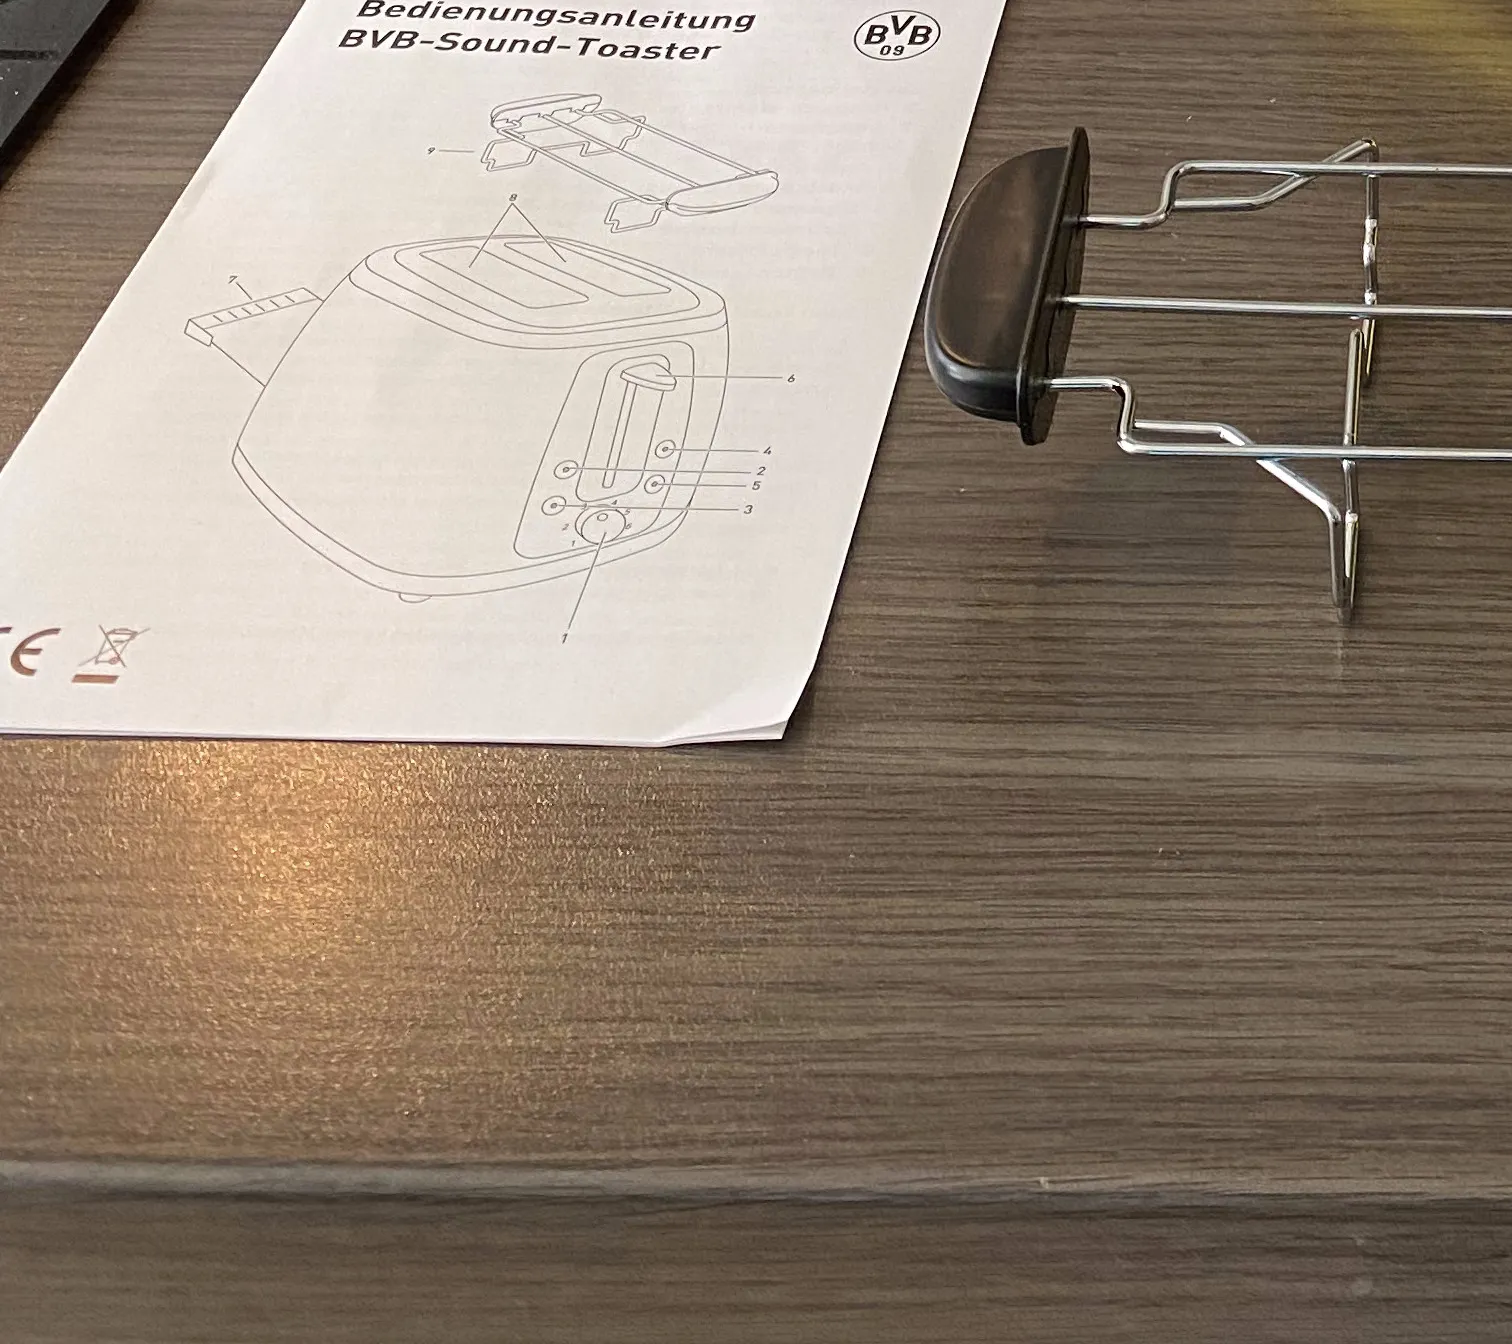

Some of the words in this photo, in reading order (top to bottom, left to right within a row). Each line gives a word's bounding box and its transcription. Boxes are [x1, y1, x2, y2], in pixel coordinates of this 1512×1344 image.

[356, 0, 757, 33] Bedienungsanleitung
[864, 15, 933, 45] BVB
[338, 29, 722, 60] BVB-Sound-Toaster
[879, 45, 905, 56] 09
[427, 147, 436, 155] 9
[508, 193, 518, 202] 8
[228, 275, 239, 284] 7
[787, 373, 796, 383] 6
[763, 446, 772, 455] 4
[756, 466, 766, 476] 2
[751, 480, 761, 491] 5
[743, 504, 753, 515] 3
[562, 632, 568, 645] 1
